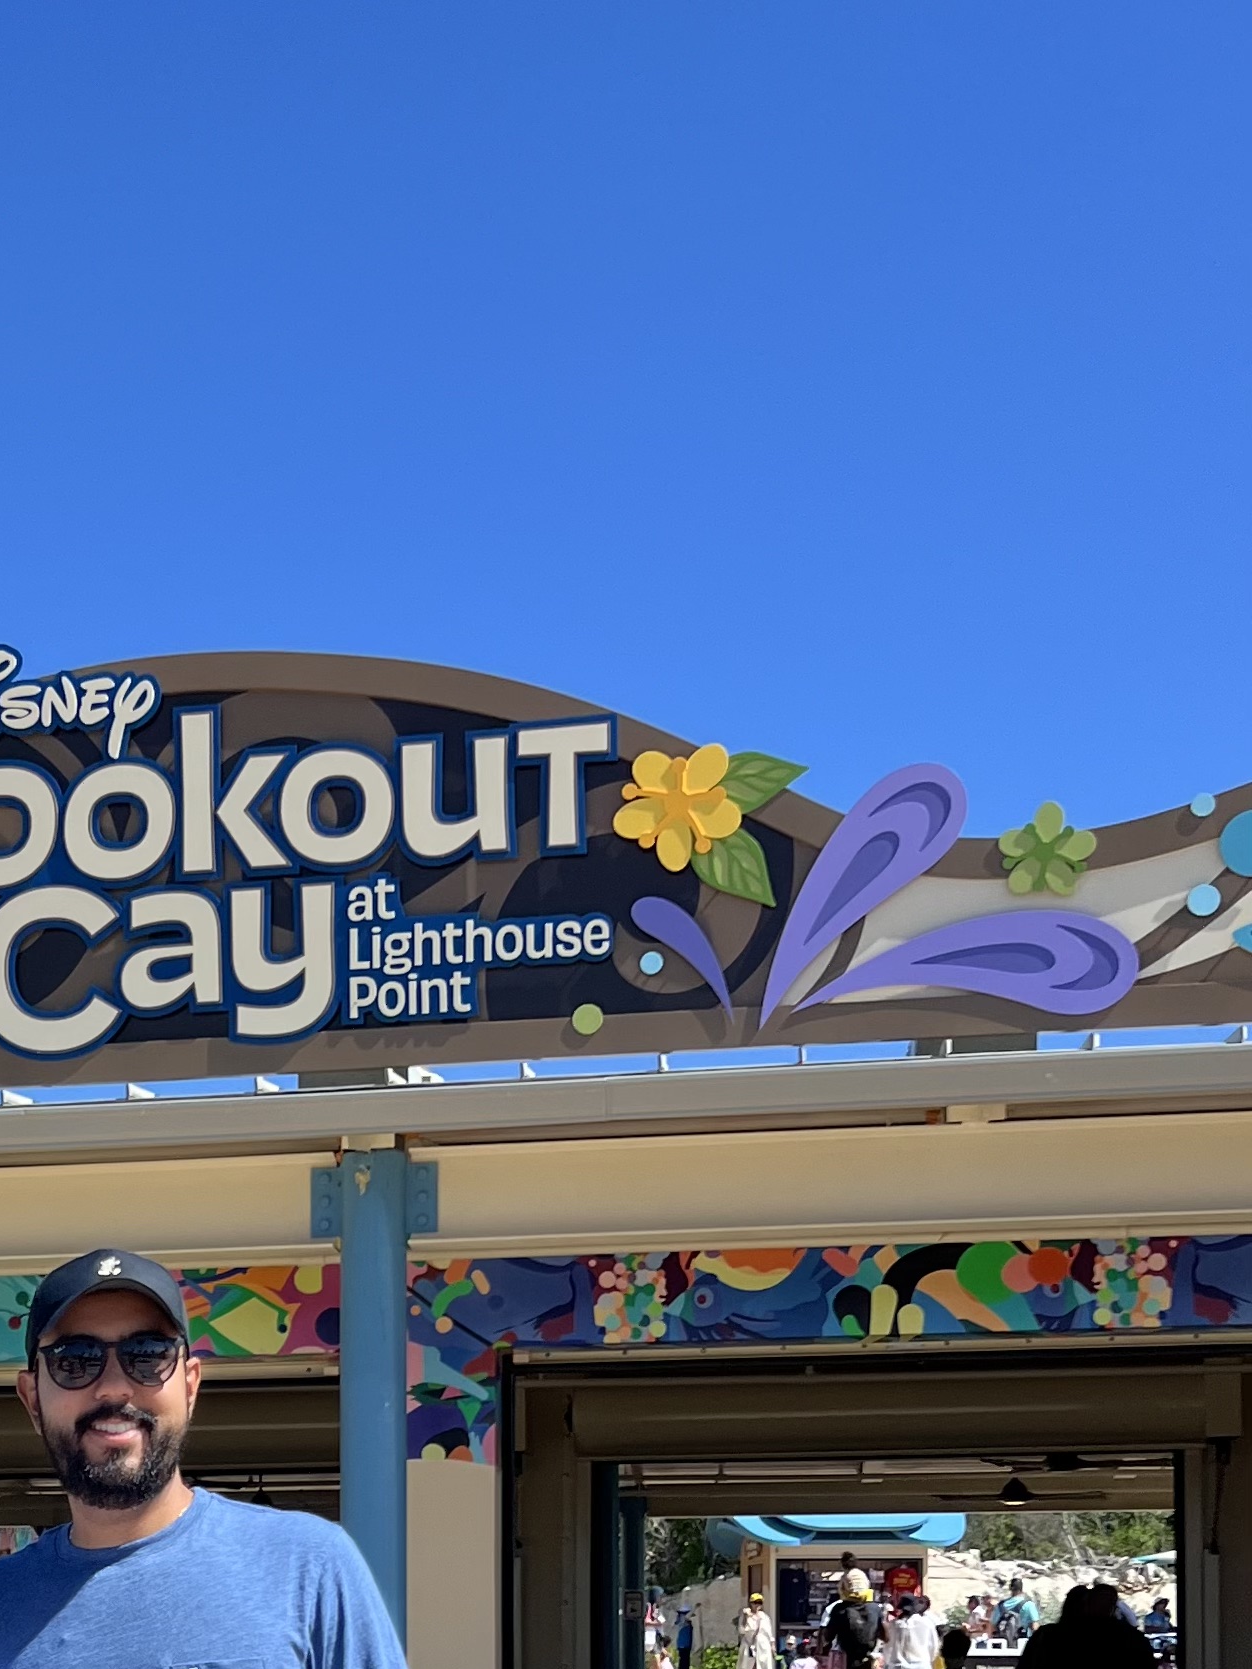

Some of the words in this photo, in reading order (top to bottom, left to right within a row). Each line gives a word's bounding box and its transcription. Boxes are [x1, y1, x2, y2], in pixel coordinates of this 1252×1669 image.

[347, 878, 397, 922] at
[348, 917, 611, 976] Lighthouse
[348, 970, 472, 1020] Point
